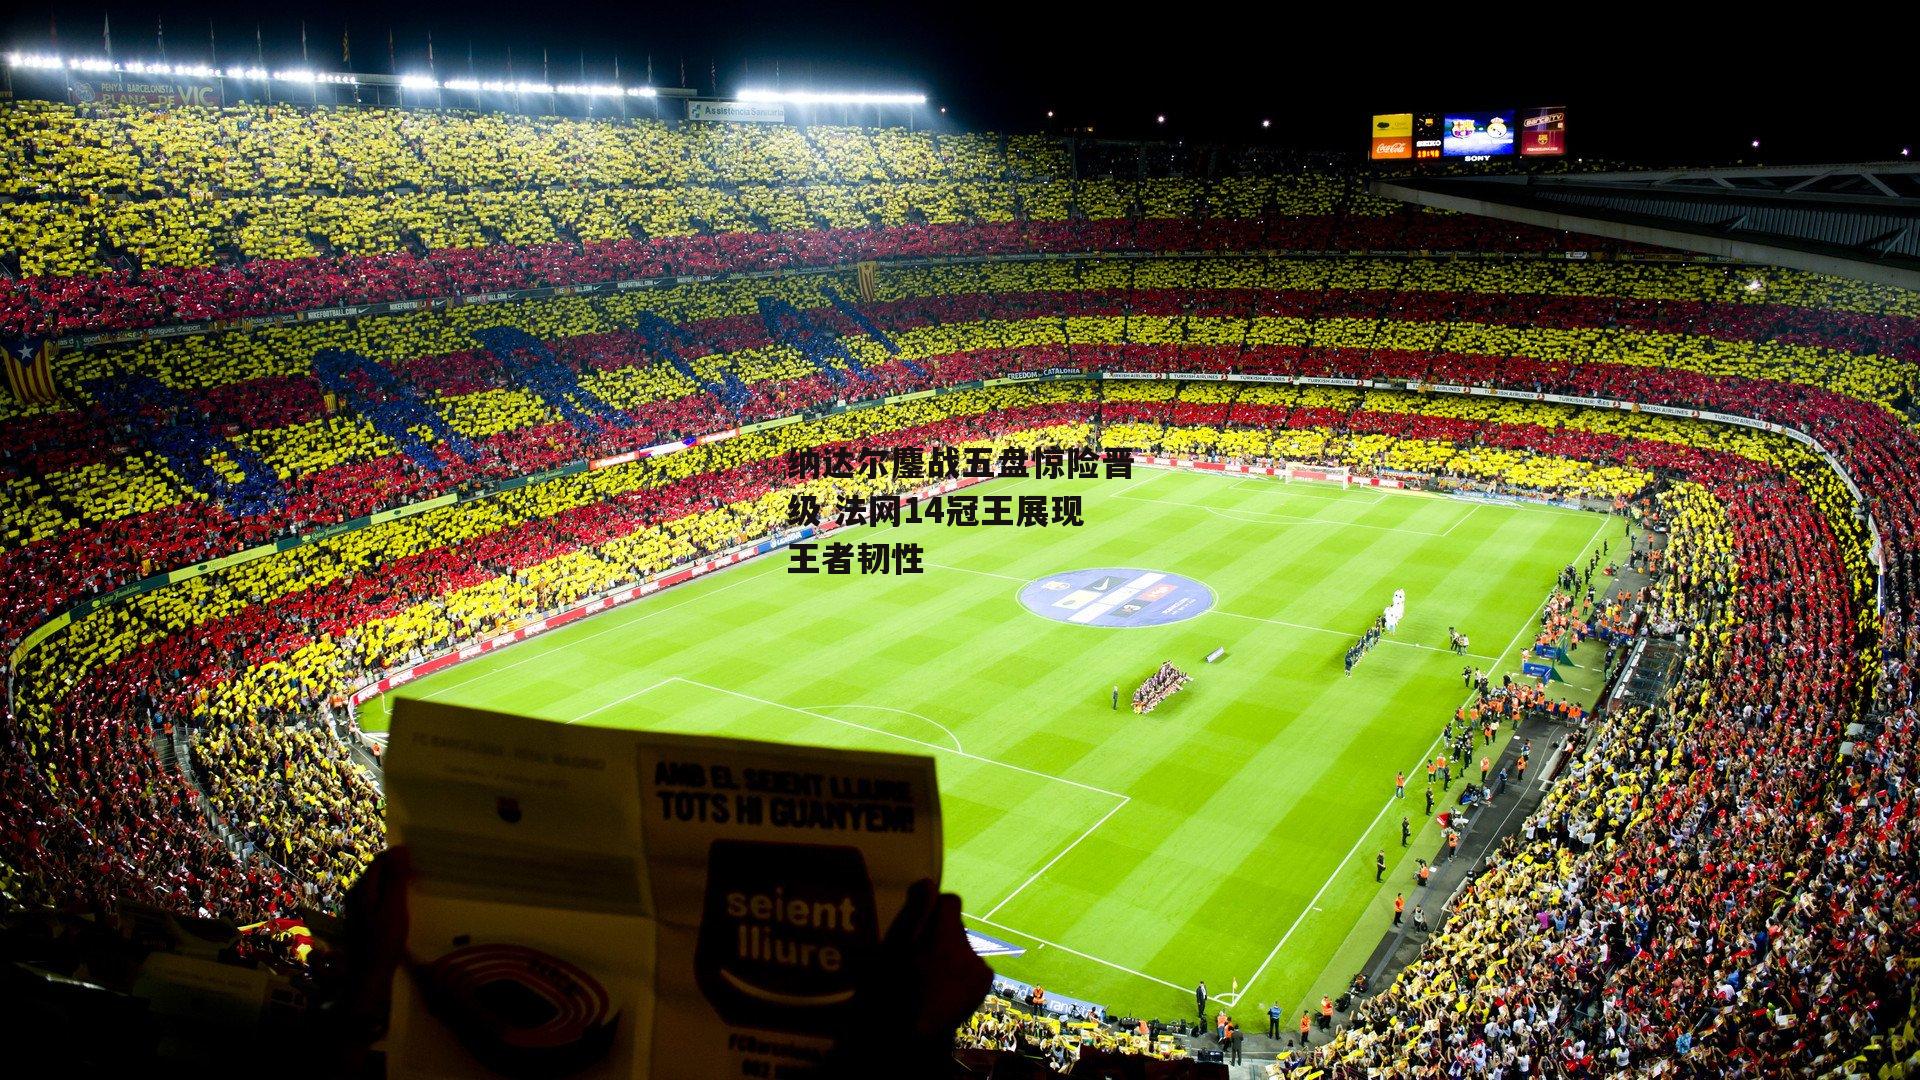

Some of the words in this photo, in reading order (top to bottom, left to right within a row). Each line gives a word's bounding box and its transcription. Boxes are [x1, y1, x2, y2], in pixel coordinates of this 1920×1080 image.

[101, 83, 123, 92] PENYA
[177, 85, 214, 107] VIC
[307, 307, 358, 320] NIKEFOOTBALL.COM
[1007, 371, 1038, 380] FREEDOM
[1043, 368, 1080, 376] CATALONIA
[655, 761, 705, 788] AMB
[711, 765, 739, 789] EL
[656, 790, 730, 824] TOTS
[736, 794, 763, 826] HI
[725, 882, 857, 934] seient
[738, 923, 844, 974] lliure
